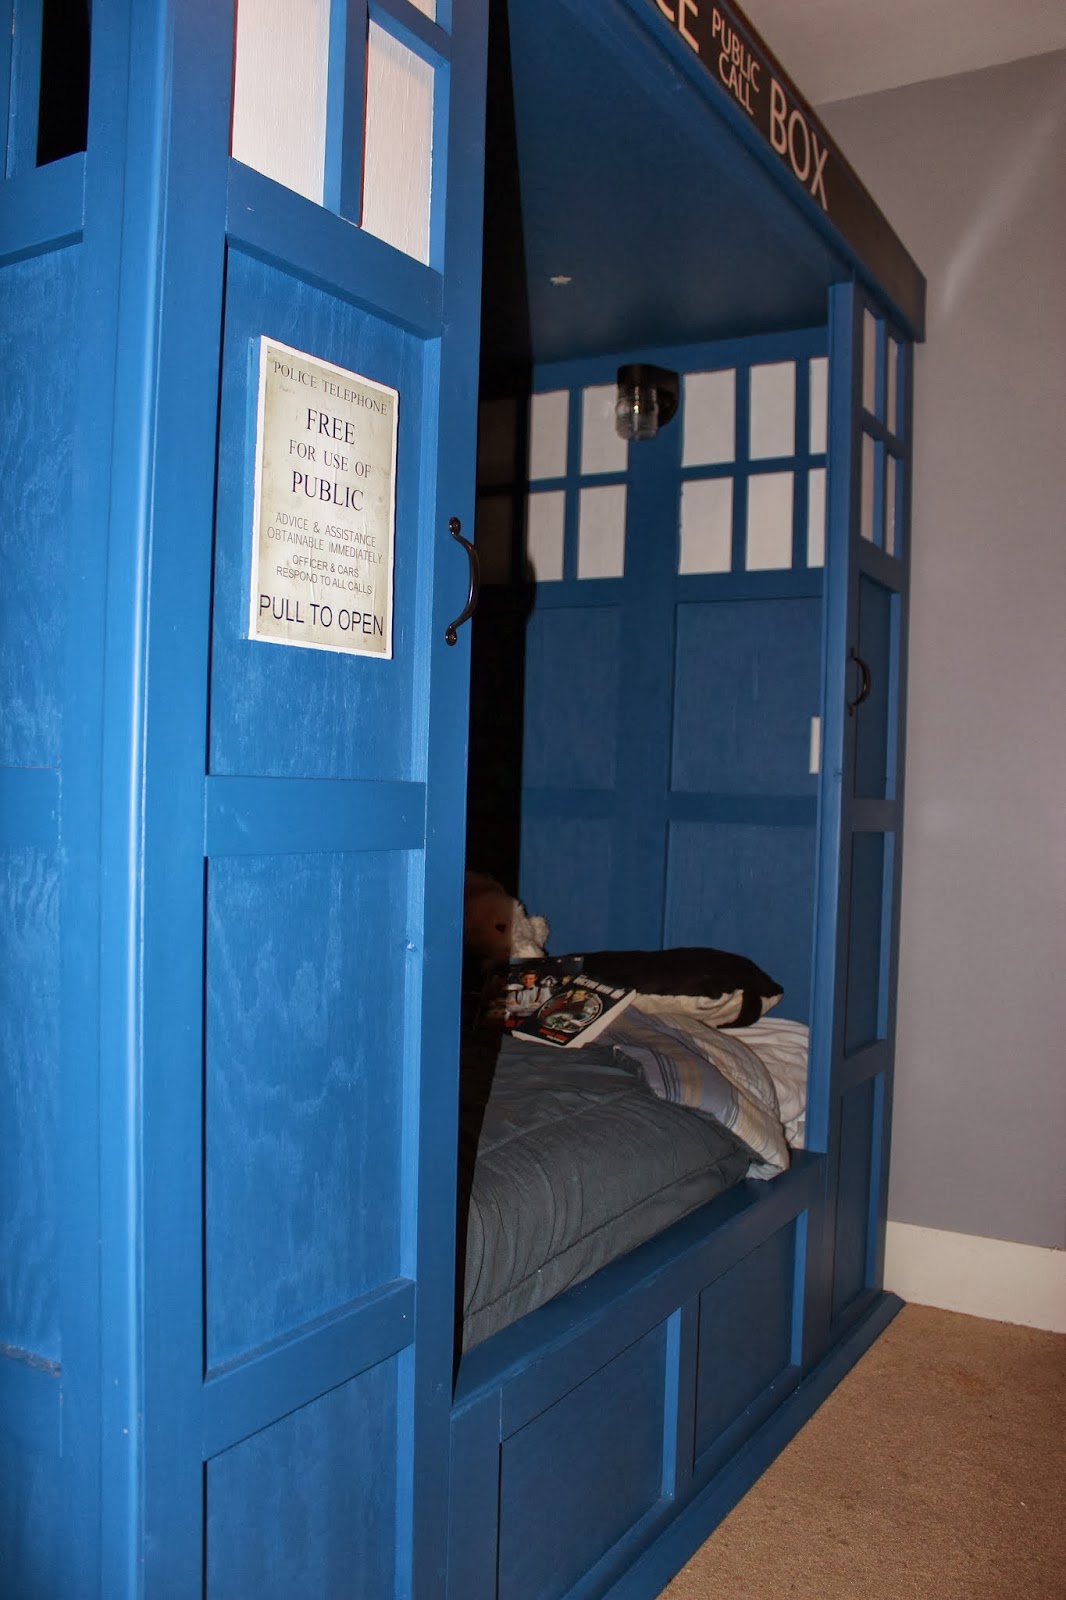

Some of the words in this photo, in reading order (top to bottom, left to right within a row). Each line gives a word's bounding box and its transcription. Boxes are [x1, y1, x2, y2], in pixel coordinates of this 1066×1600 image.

[712, 8, 761, 92] PUBLIC
[719, 52, 754, 115] CALL
[770, 78, 828, 210] BOX
[274, 361, 318, 388] POLICE
[321, 380, 388, 416] TELEPHONE
[306, 408, 356, 445] FREE
[289, 439, 316, 462] FOR
[324, 450, 349, 471] USE
[355, 461, 372, 478] OF
[292, 470, 364, 511] PUBLIC
[267, 526, 324, 551] OBTAINABLE
[328, 541, 382, 564] IMMEDIATELY
[276, 512, 309, 531] ADVICE
[313, 521, 320, 533] &
[325, 525, 377, 548] ASSISTANCE
[276, 566, 318, 583] RESPOND
[320, 575, 331, 586] TO
[332, 577, 346, 589] ALL
[348, 581, 372, 595] CALLS
[292, 555, 328, 572] OFFICER
[330, 562, 336, 573] &
[337, 563, 359, 578] CARS
[259, 594, 305, 624] PULL
[309, 603, 333, 627] TO
[338, 608, 384, 636] OPEN
